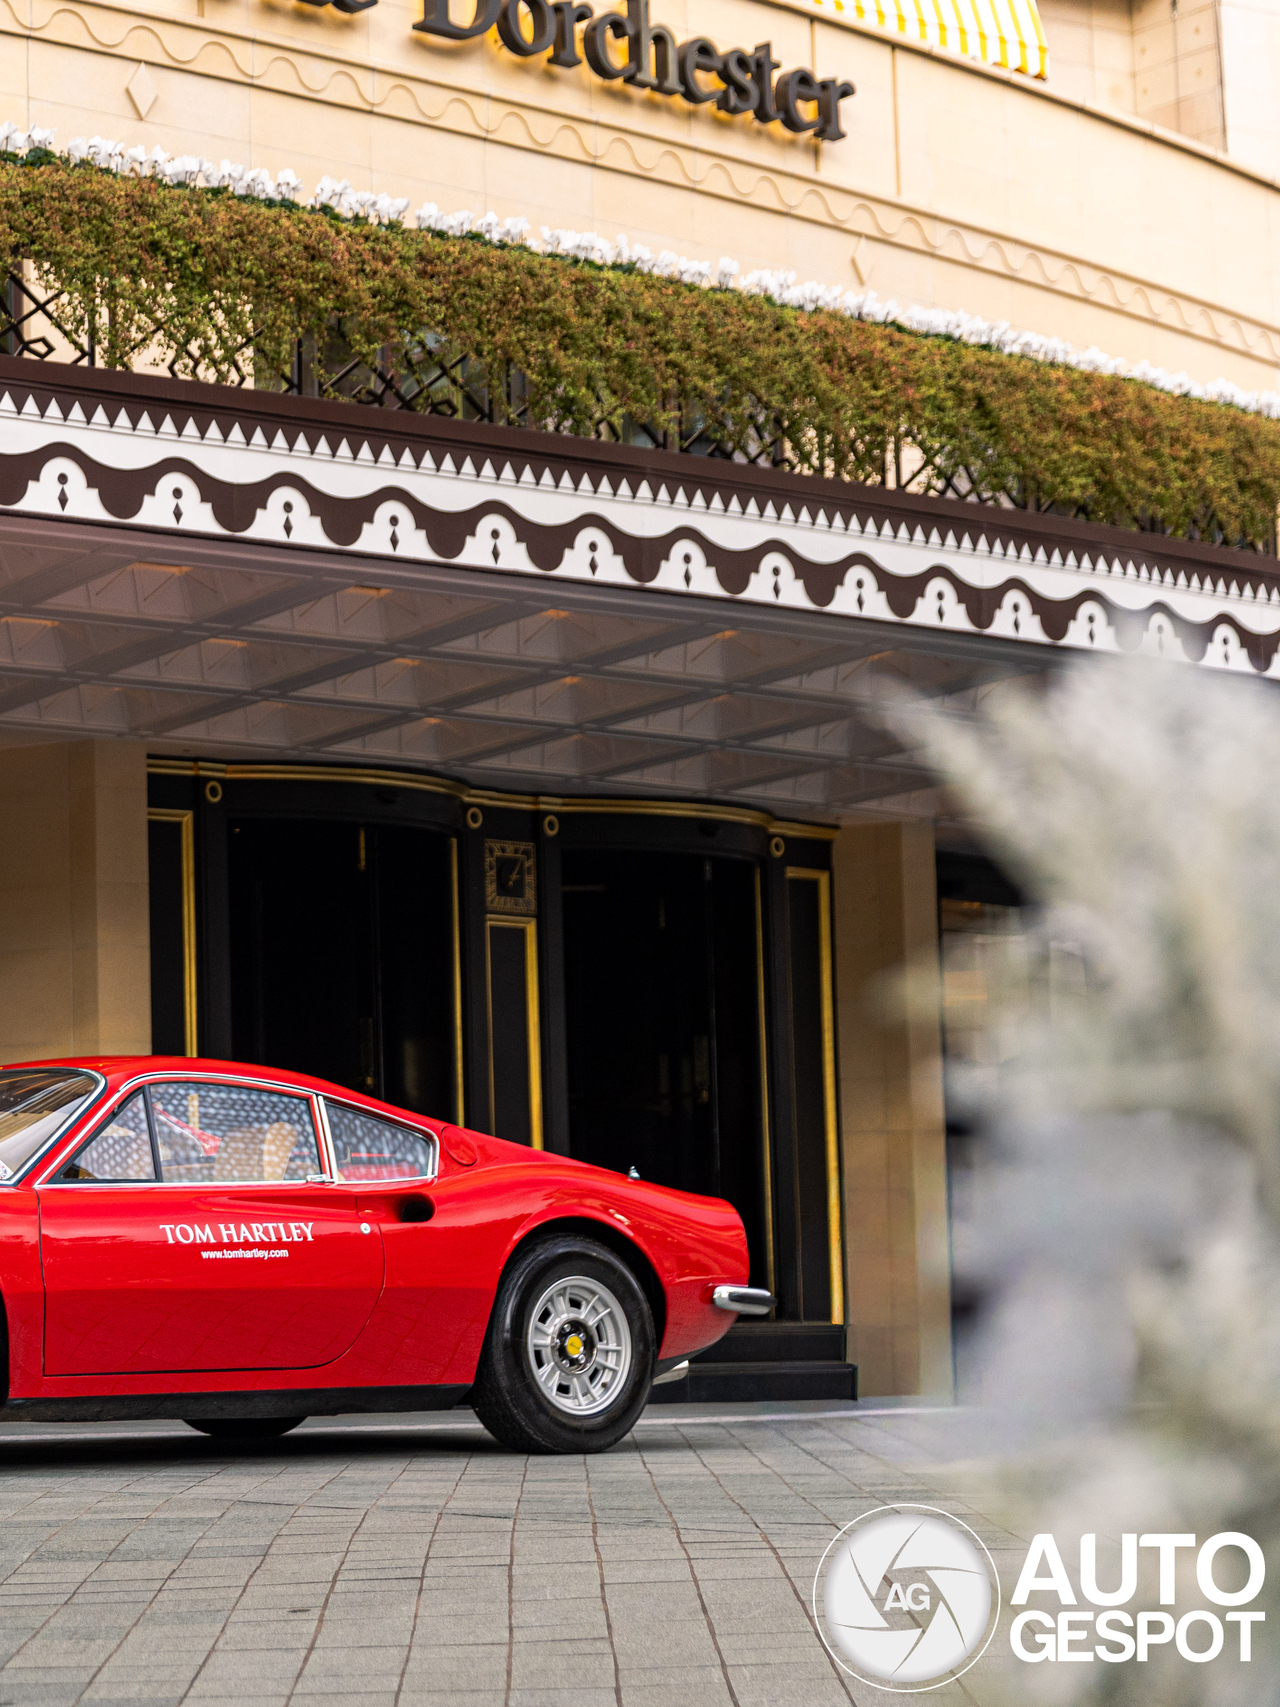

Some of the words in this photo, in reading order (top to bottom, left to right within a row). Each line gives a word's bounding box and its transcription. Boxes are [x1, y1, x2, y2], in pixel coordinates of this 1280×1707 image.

[159, 1223, 217, 1244] TOM
[218, 1222, 314, 1243] HARTLEY
[201, 1248, 289, 1260] www.tomhartley.com
